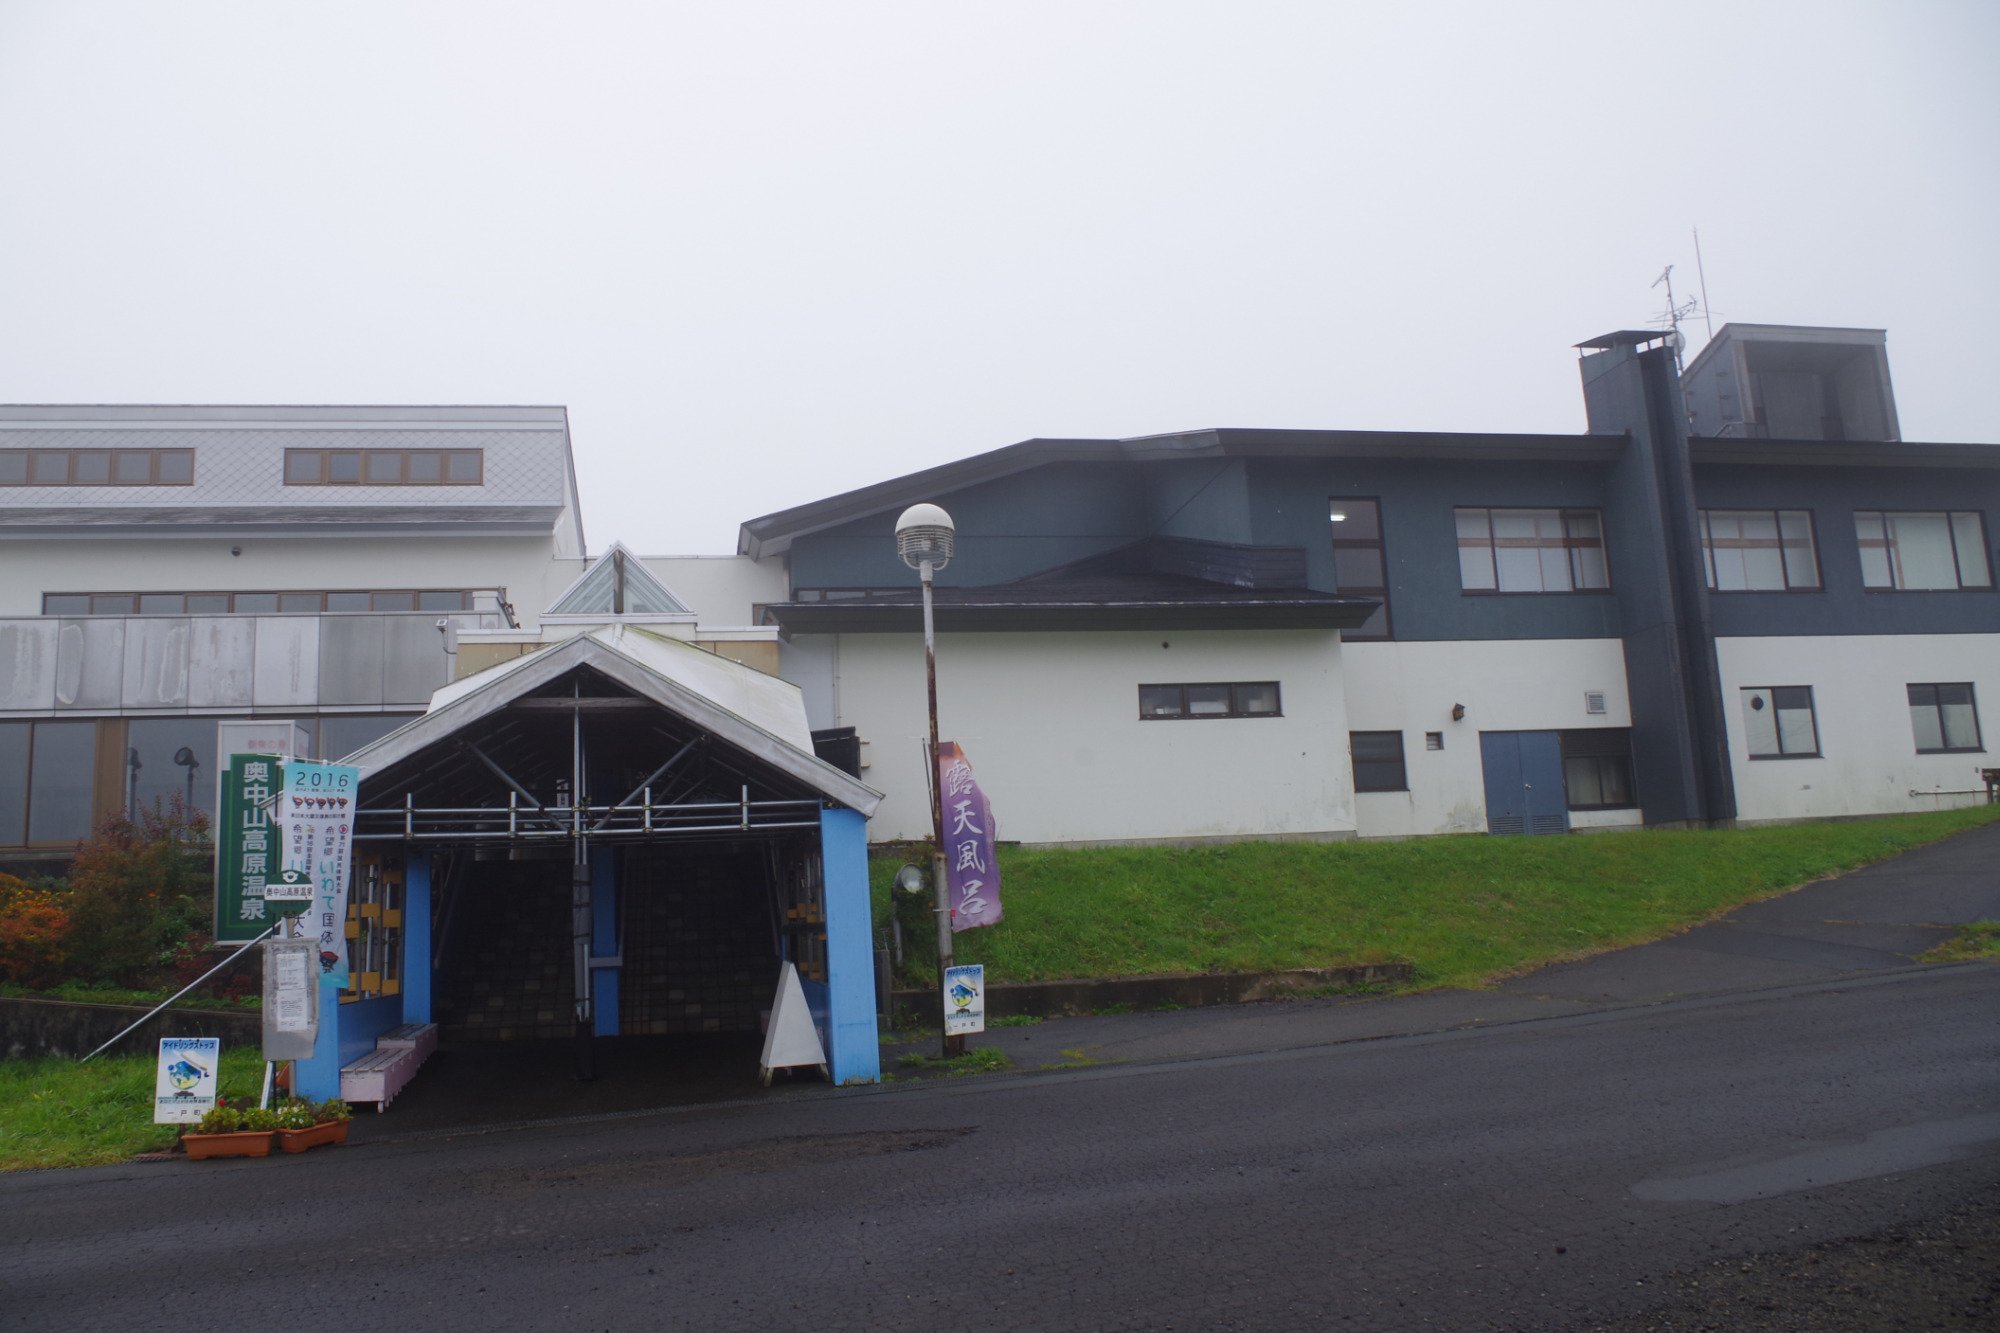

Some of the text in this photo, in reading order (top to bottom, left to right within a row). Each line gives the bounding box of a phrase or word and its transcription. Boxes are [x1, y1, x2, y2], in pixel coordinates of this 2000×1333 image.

[296, 771, 349, 787] 2016
[945, 759, 988, 915] 露天風呂
[240, 761, 268, 921] 奥中山高原温泉
[266, 887, 313, 897] 奥中山高原温泉
[320, 825, 336, 944] 希望郷いわて国体
